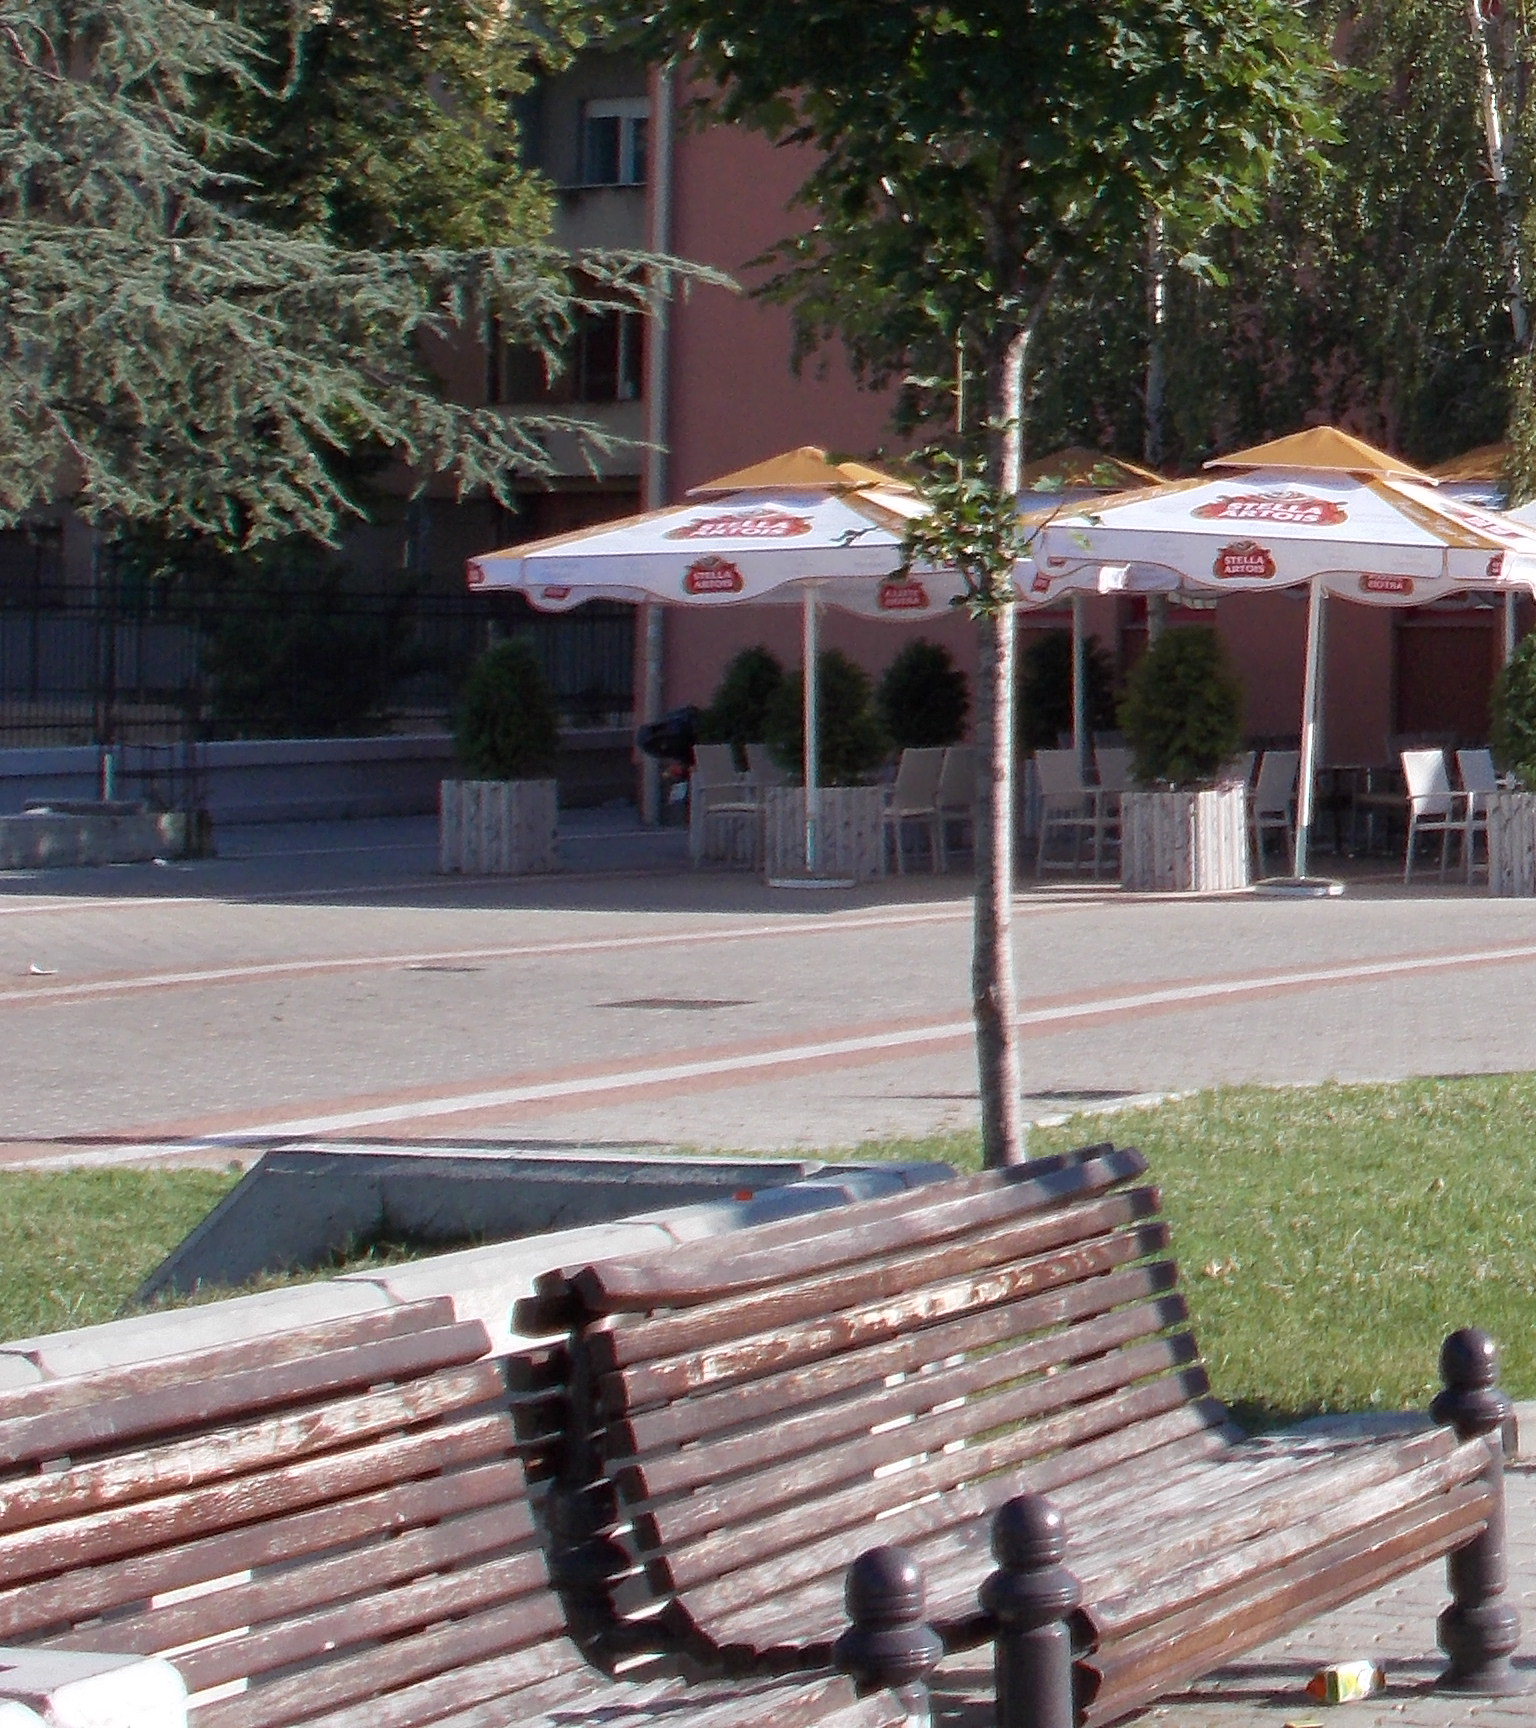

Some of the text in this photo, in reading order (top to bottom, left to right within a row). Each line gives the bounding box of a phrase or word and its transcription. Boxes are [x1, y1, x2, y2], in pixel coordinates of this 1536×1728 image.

[1227, 502, 1322, 515] STELLA
[1218, 510, 1320, 522] ARTOIS
[1224, 556, 1264, 566] STELLA
[1224, 565, 1265, 574] ARTOIS
